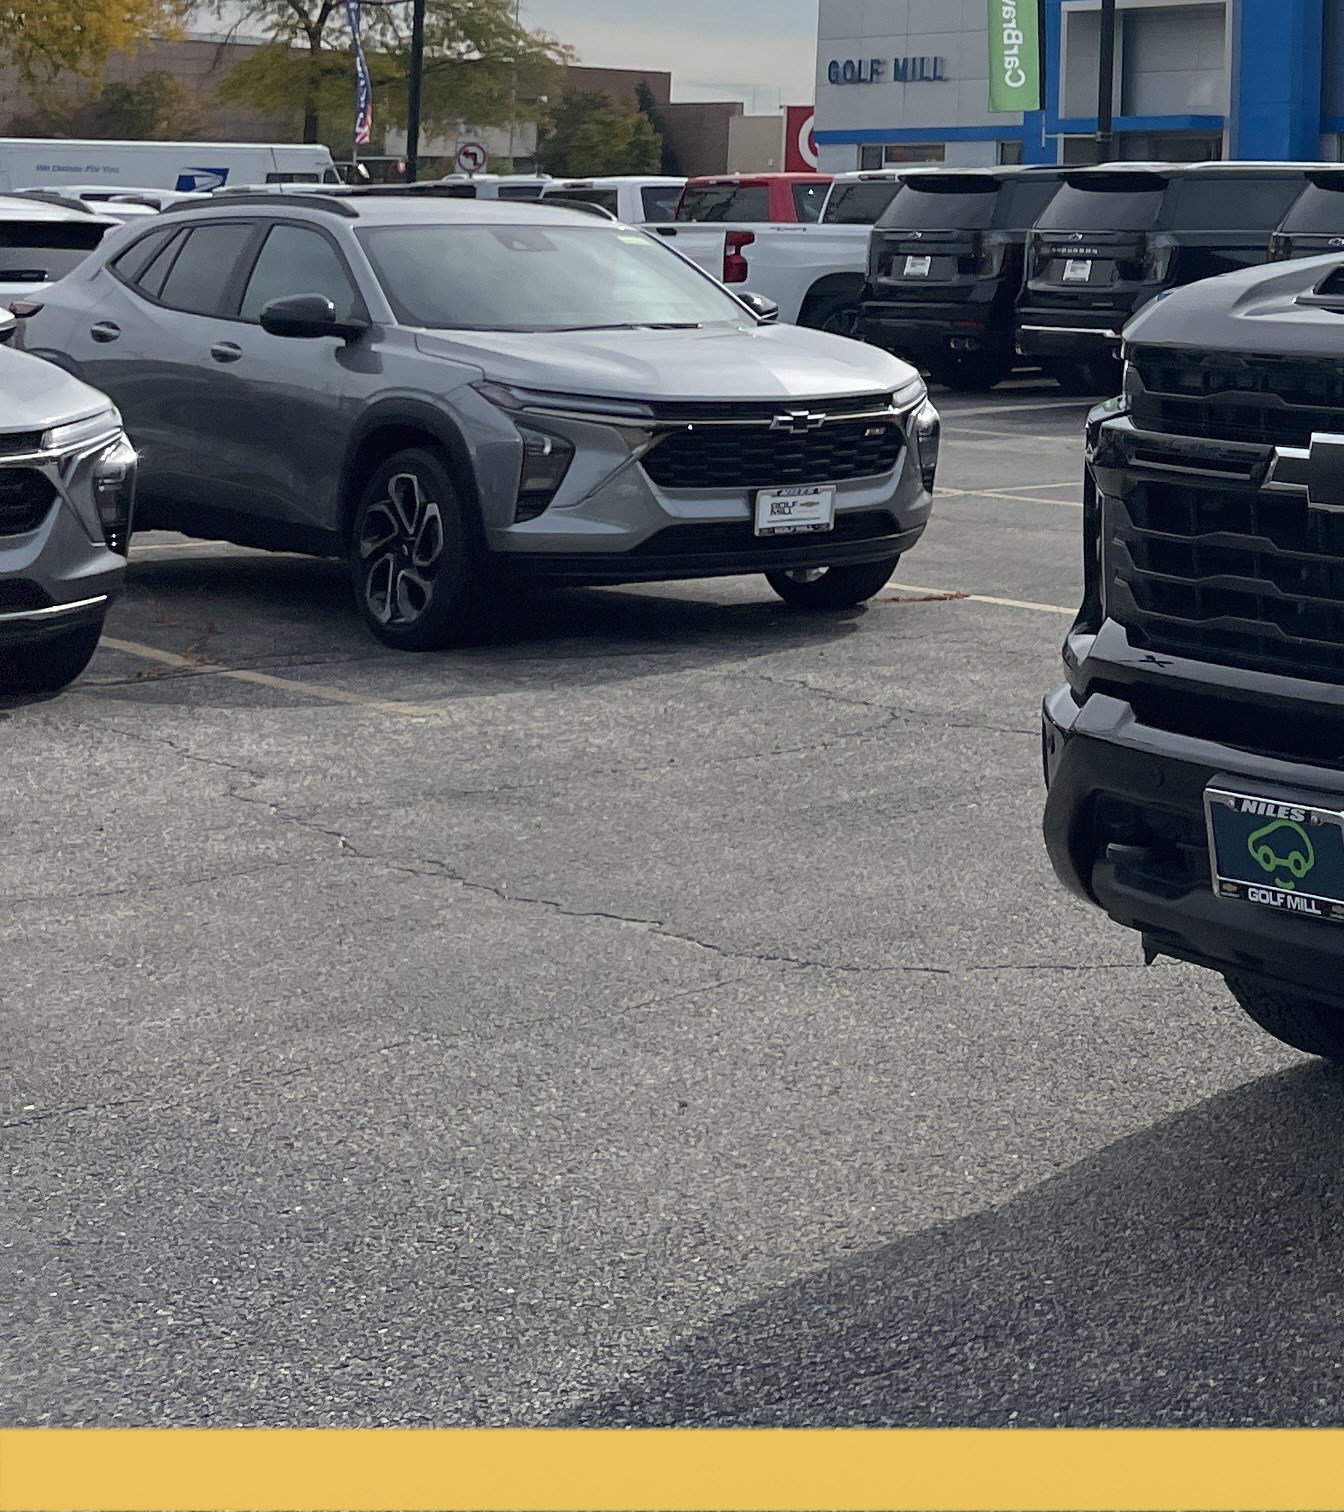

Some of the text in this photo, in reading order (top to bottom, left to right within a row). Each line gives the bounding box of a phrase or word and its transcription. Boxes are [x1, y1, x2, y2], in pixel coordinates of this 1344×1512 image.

[827, 56, 948, 85] GOLF MILL
[1241, 799, 1306, 822] NILES
[1248, 888, 1286, 906] GOLF
[1286, 895, 1322, 915] MILL
